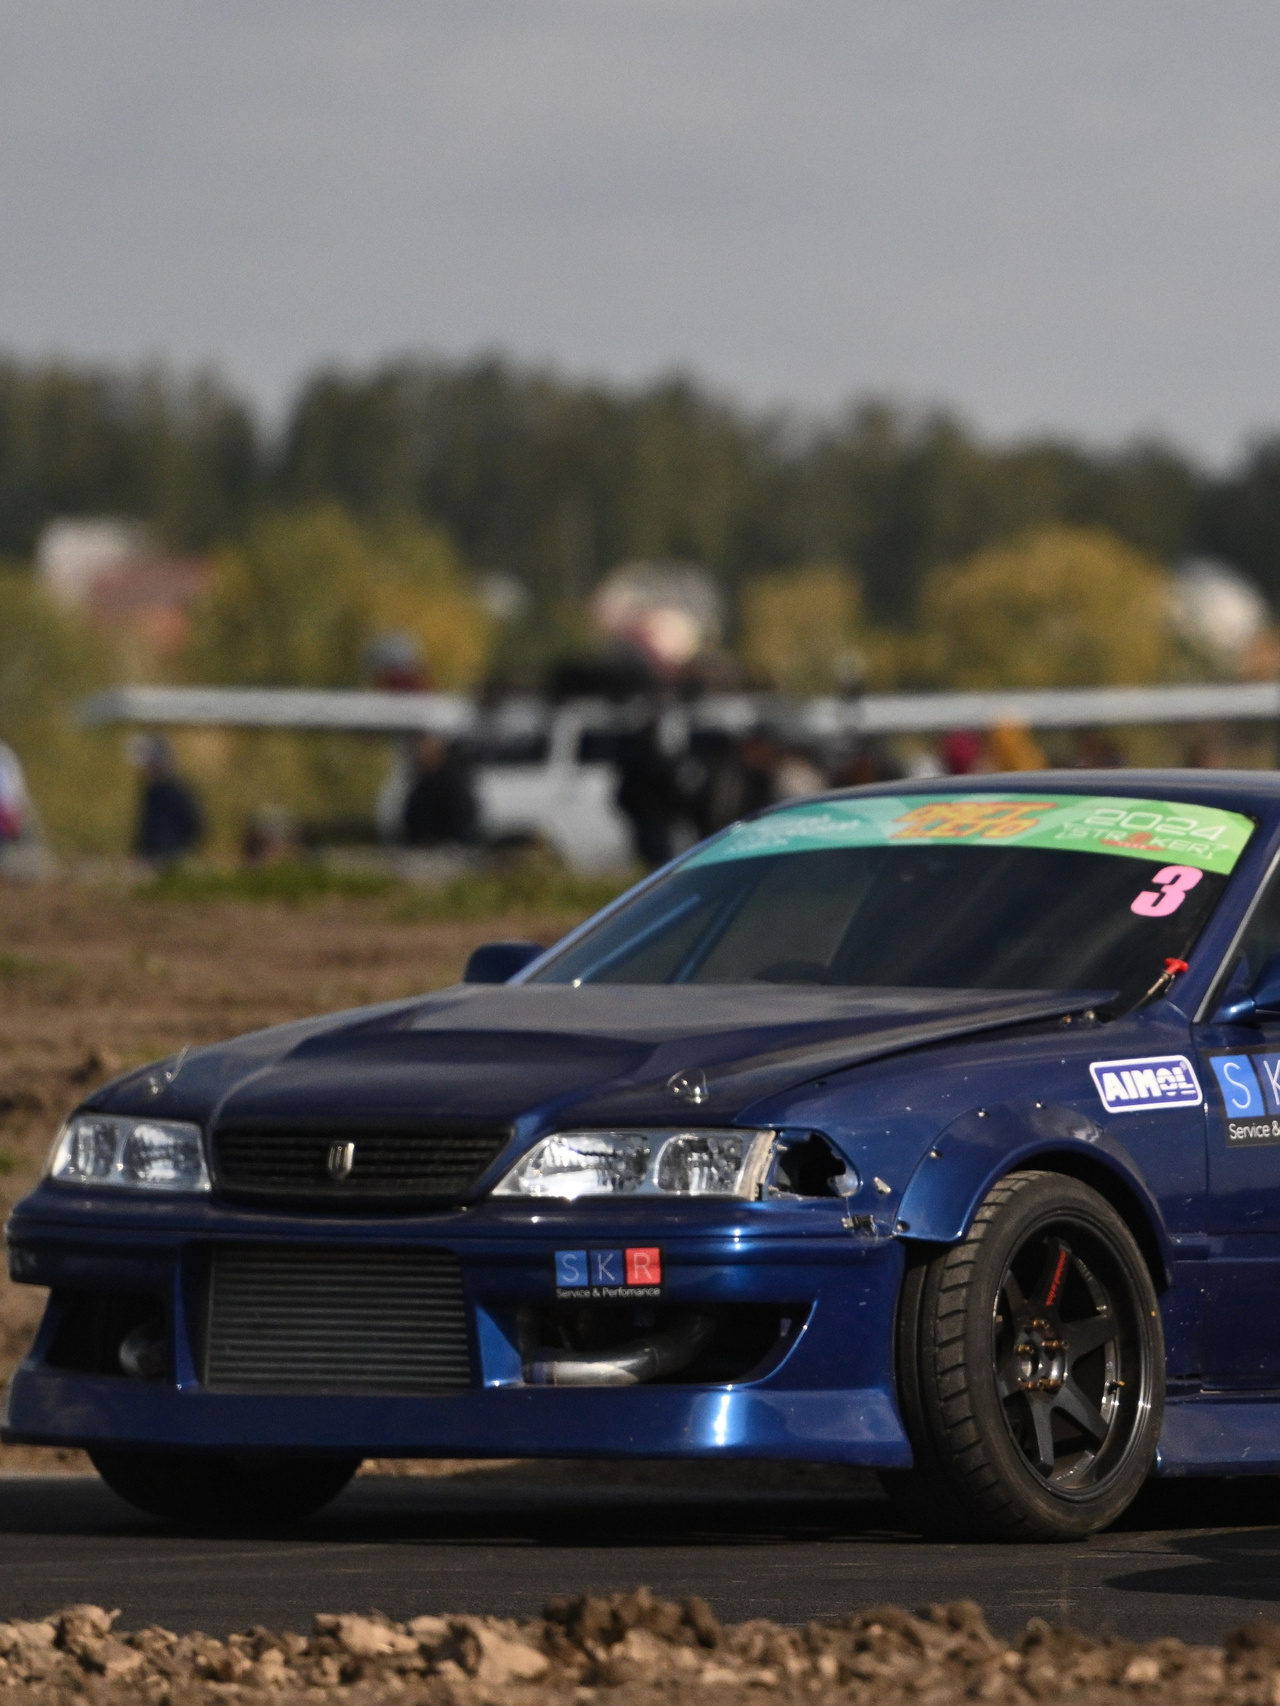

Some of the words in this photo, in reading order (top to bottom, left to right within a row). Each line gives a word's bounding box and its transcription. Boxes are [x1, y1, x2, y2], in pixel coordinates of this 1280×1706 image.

[1084, 808, 1228, 841] 2024
[1130, 865, 1204, 918] 3
[1101, 1066, 1197, 1102] AIMOL
[1228, 1123, 1271, 1140] Service
[560, 1251, 655, 1284] SKR
[555, 1287, 591, 1299] Service
[592, 1287, 601, 1298] &
